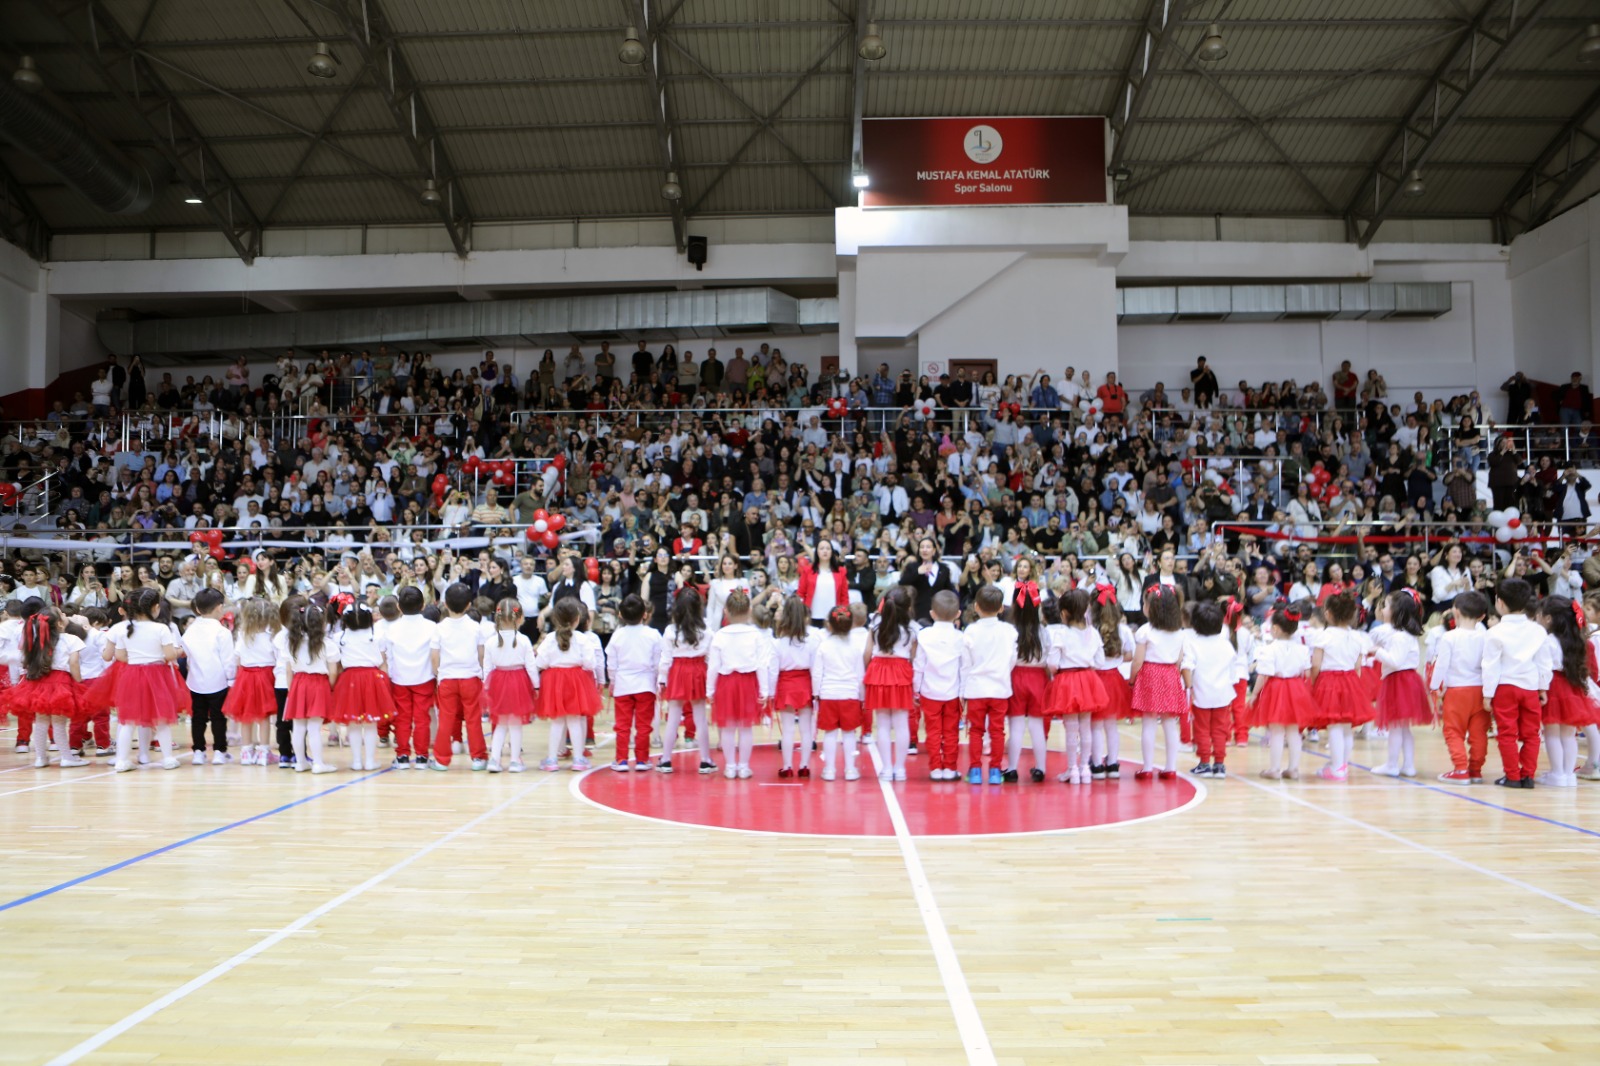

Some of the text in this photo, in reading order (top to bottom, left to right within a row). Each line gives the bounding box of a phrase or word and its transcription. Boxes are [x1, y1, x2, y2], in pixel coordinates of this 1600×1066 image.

[917, 168, 1050, 180] MUSTAFA KEMAL ATATÜRK
[954, 183, 1012, 194] Spor Salonu
